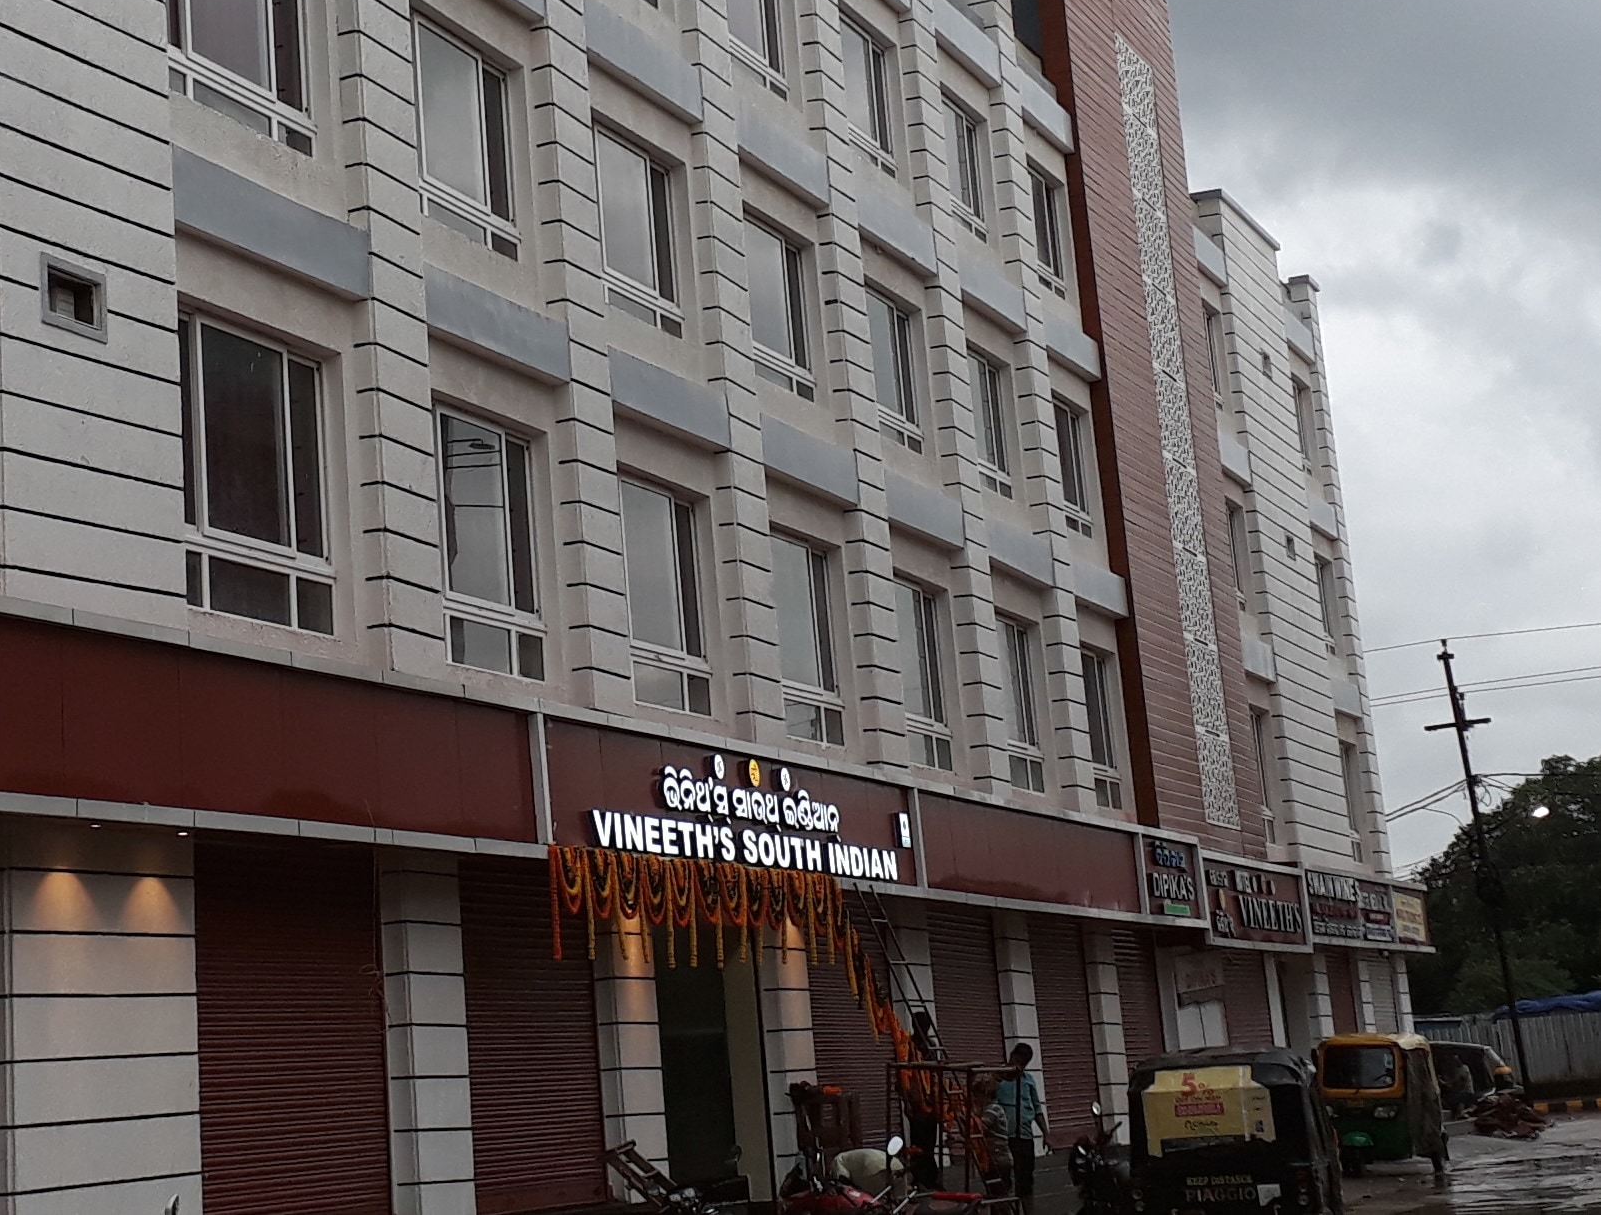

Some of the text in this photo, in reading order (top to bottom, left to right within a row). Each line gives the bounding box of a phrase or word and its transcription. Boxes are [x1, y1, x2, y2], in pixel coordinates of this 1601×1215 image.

[592, 809, 899, 881] VINEETH'S SOUTH INDIAN
[1153, 872, 1196, 902] DIPIKA'S
